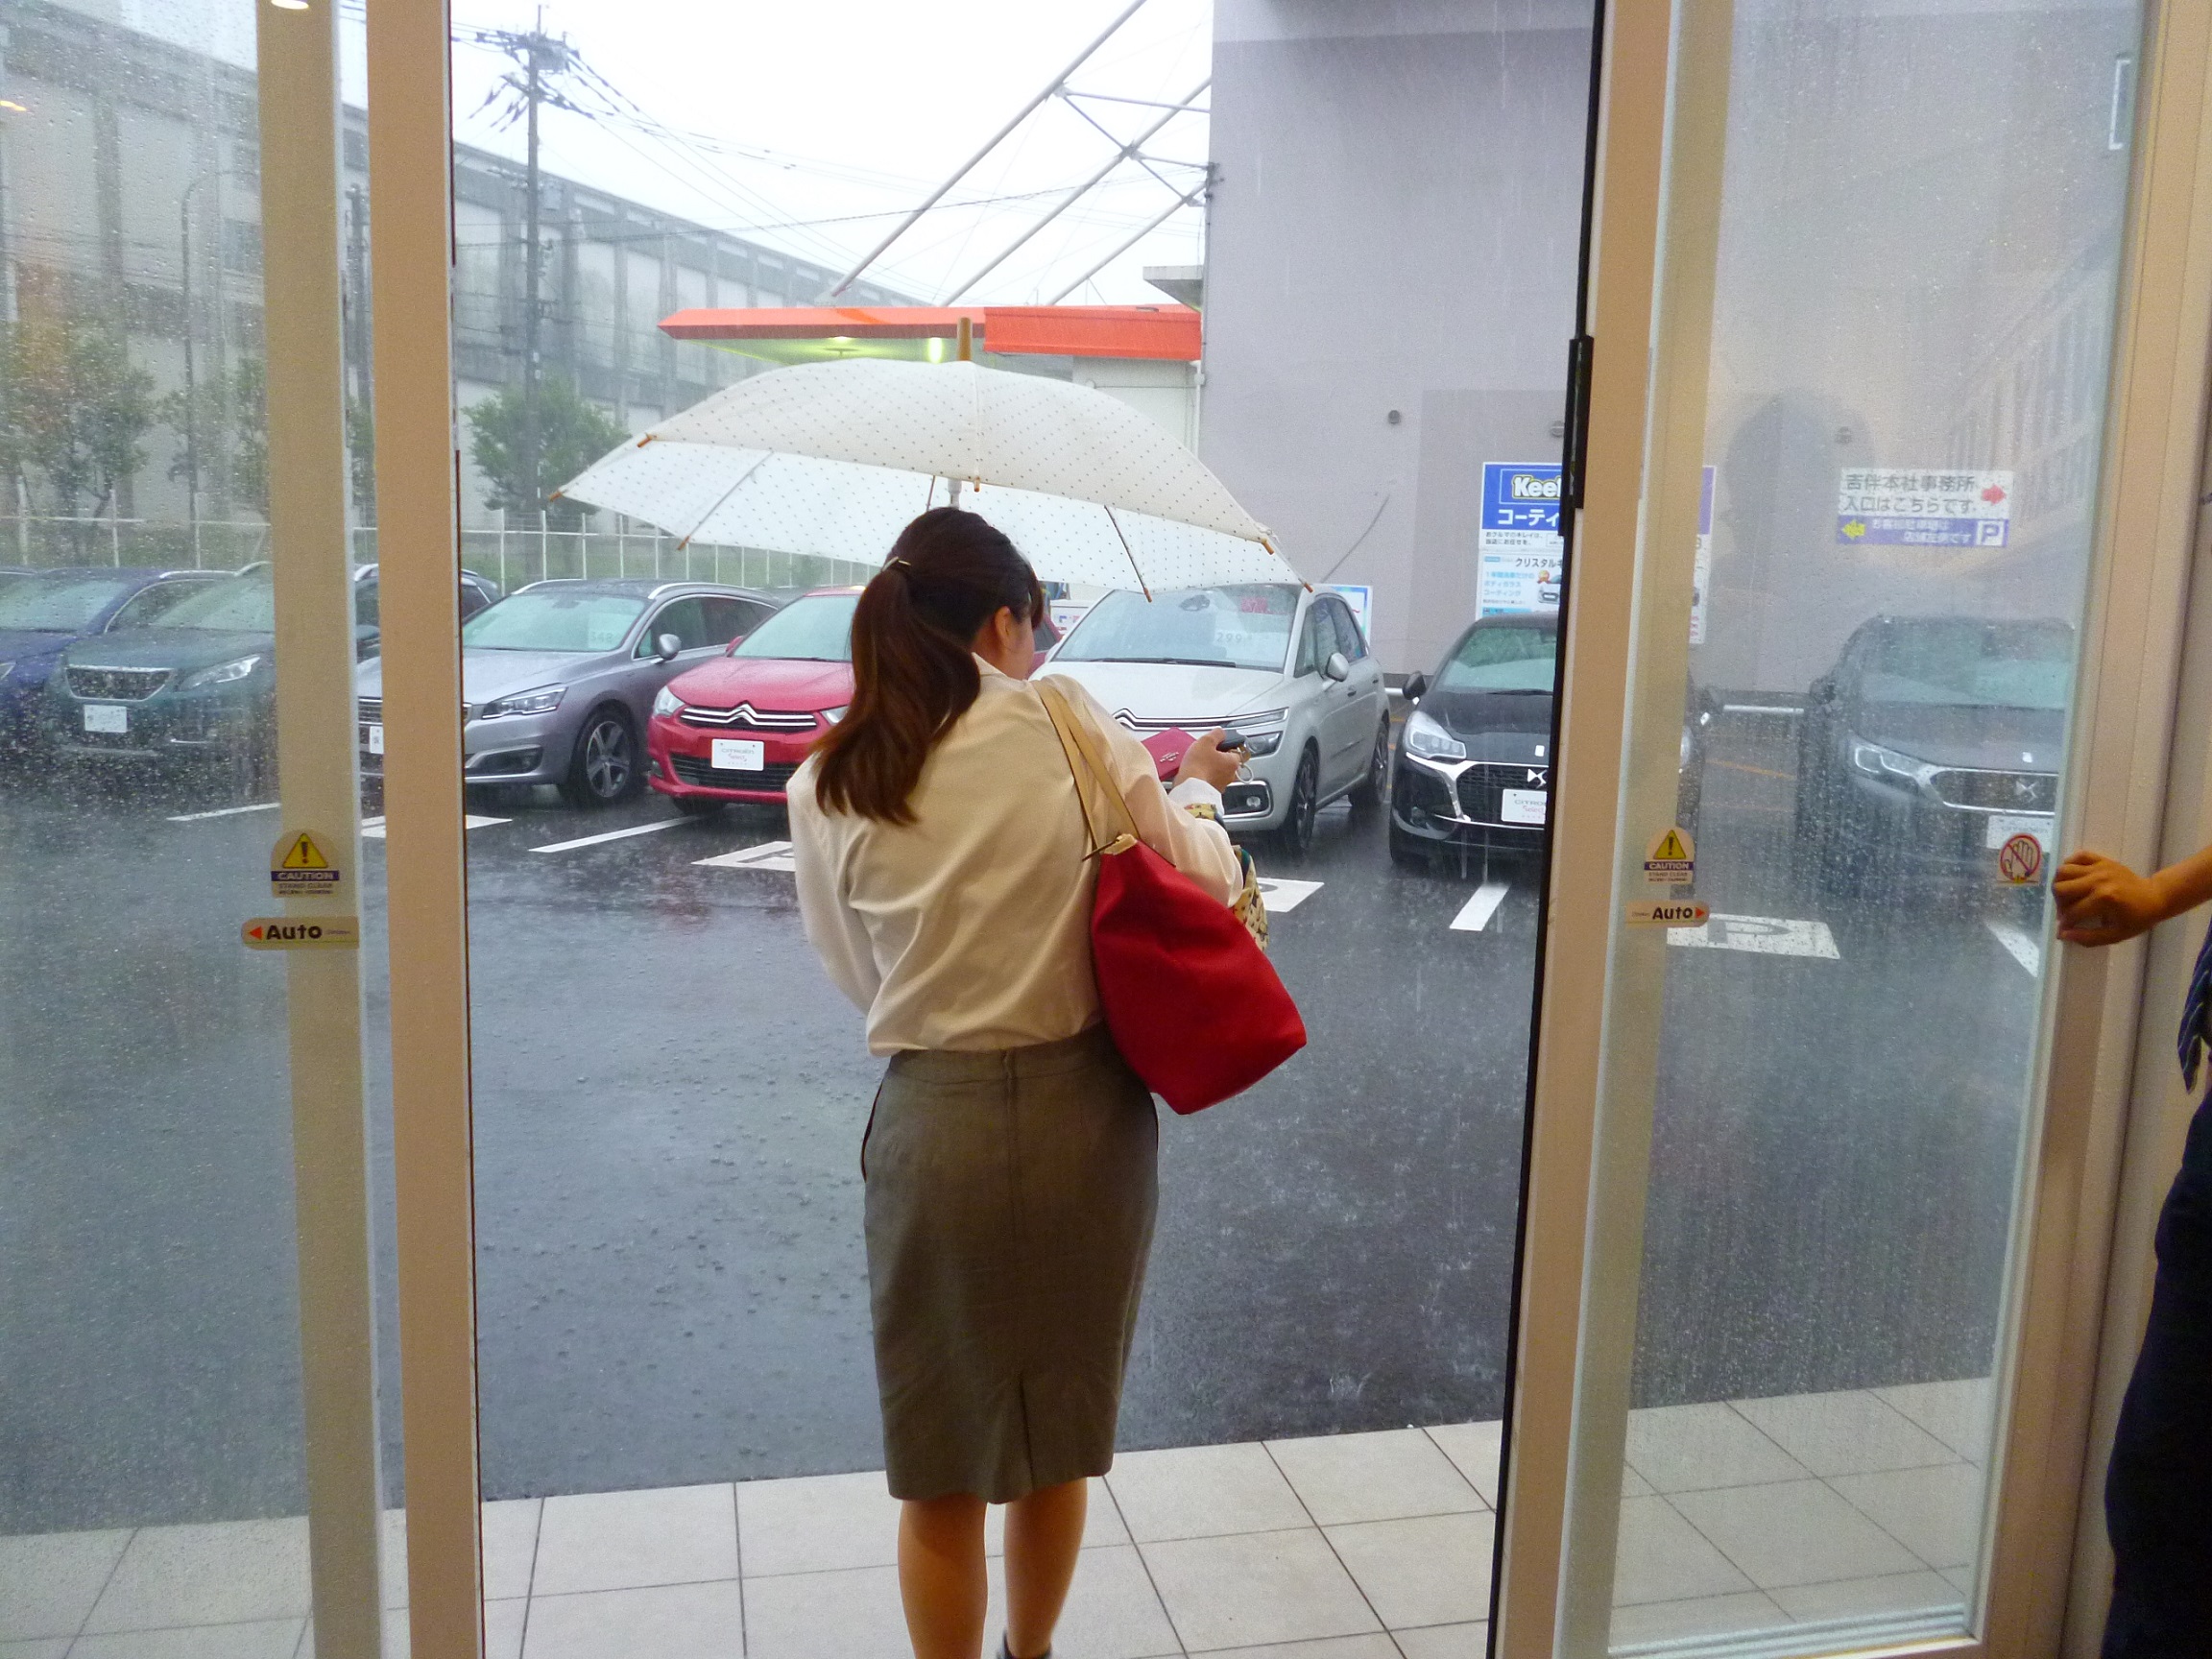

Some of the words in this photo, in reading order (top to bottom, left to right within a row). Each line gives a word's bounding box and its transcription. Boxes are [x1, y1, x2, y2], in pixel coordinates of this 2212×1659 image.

[1981, 524, 2001, 543] P
[276, 872, 334, 880] CAUTION
[1651, 906, 1694, 920] Auto
[266, 925, 323, 940] Auto
